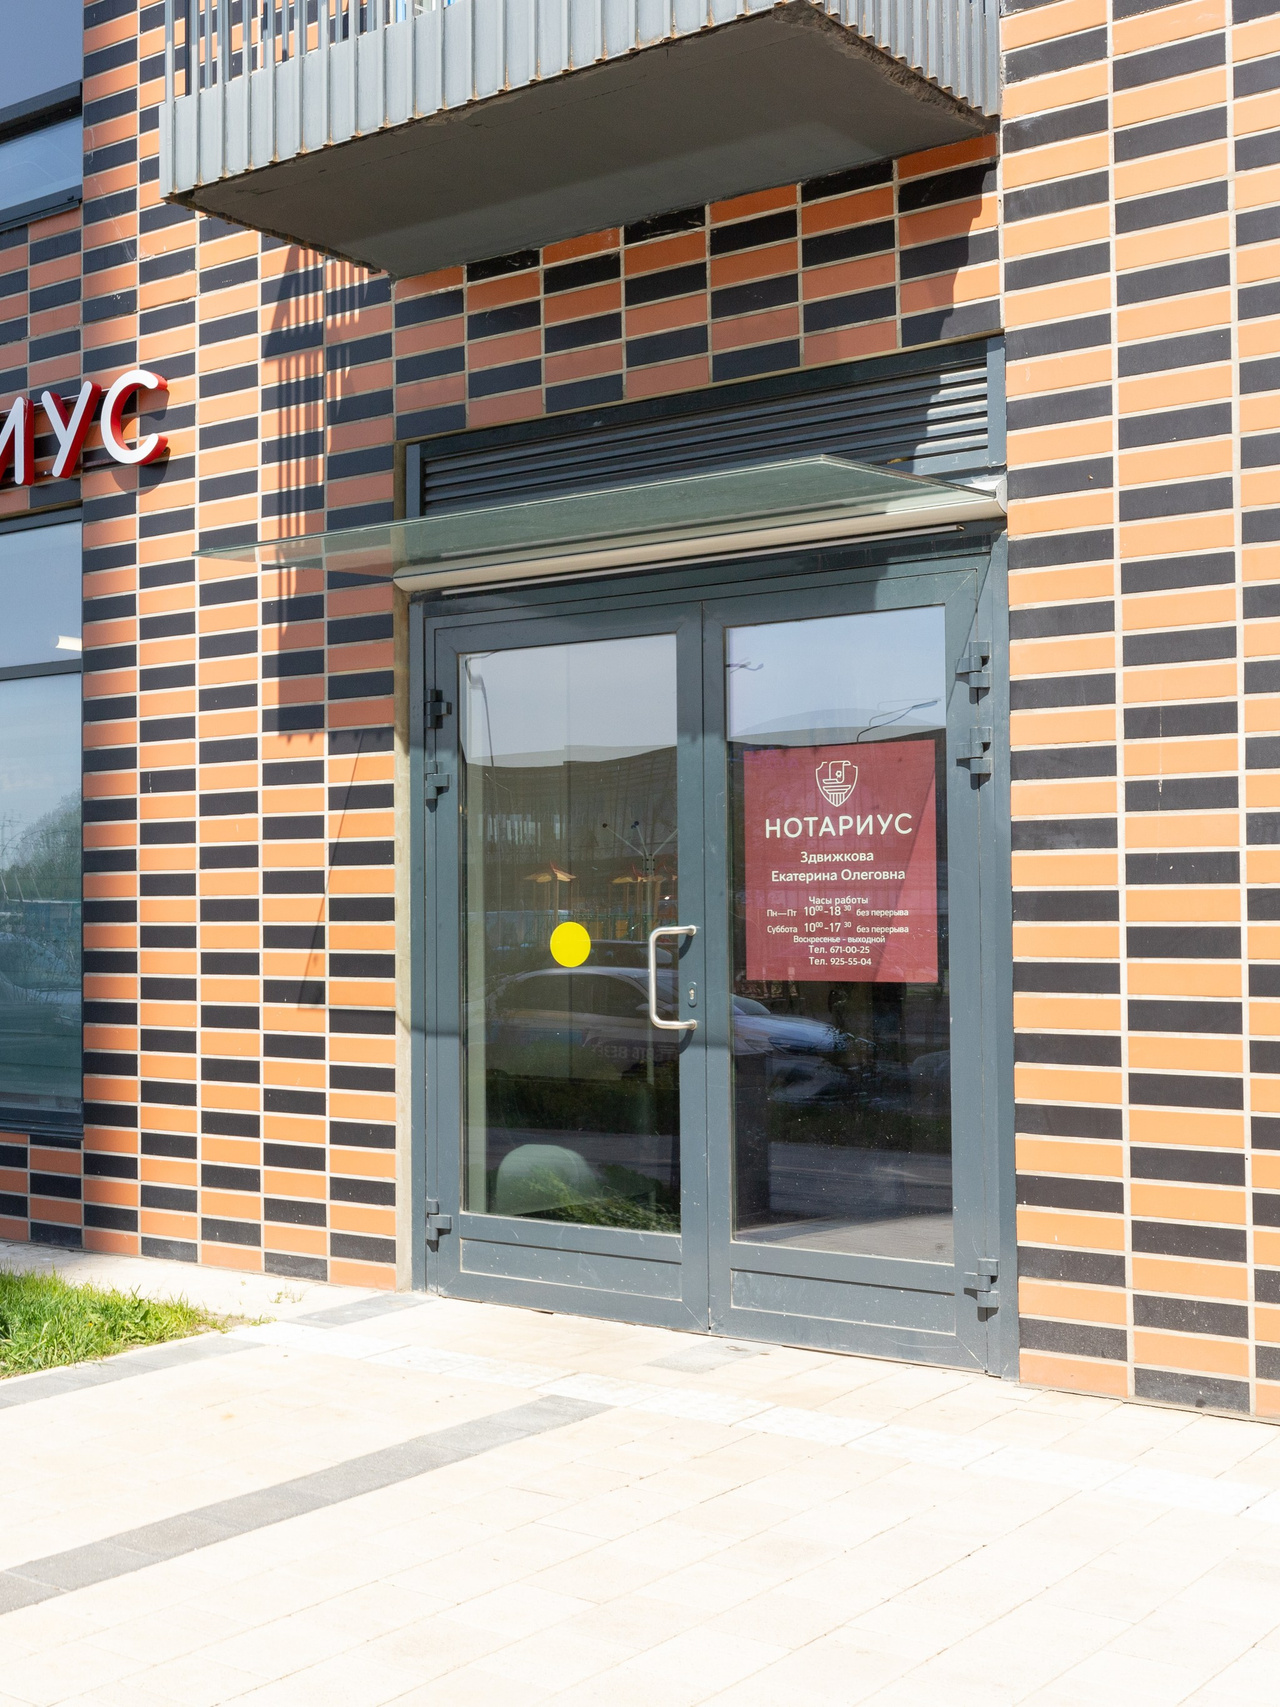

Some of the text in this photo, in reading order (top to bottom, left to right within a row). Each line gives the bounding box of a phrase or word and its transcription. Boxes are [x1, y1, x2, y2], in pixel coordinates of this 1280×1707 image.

[765, 812, 913, 839] НОТАРИУС
[800, 851, 874, 864] Здвижкова
[771, 868, 906, 884] Екатерина Олеговна
[808, 895, 869, 906] Часы работы
[856, 909, 869, 917] без
[871, 910, 909, 918] перерыва
[767, 925, 798, 935] Суббота
[856, 925, 870, 933] без
[871, 926, 909, 935] перерыва
[793, 935, 841, 943] Воскресенье
[847, 935, 886, 944] выходной
[808, 945, 870, 954] Тел. 671-00-25
[808, 957, 872, 966] Тел. 925-55-04
